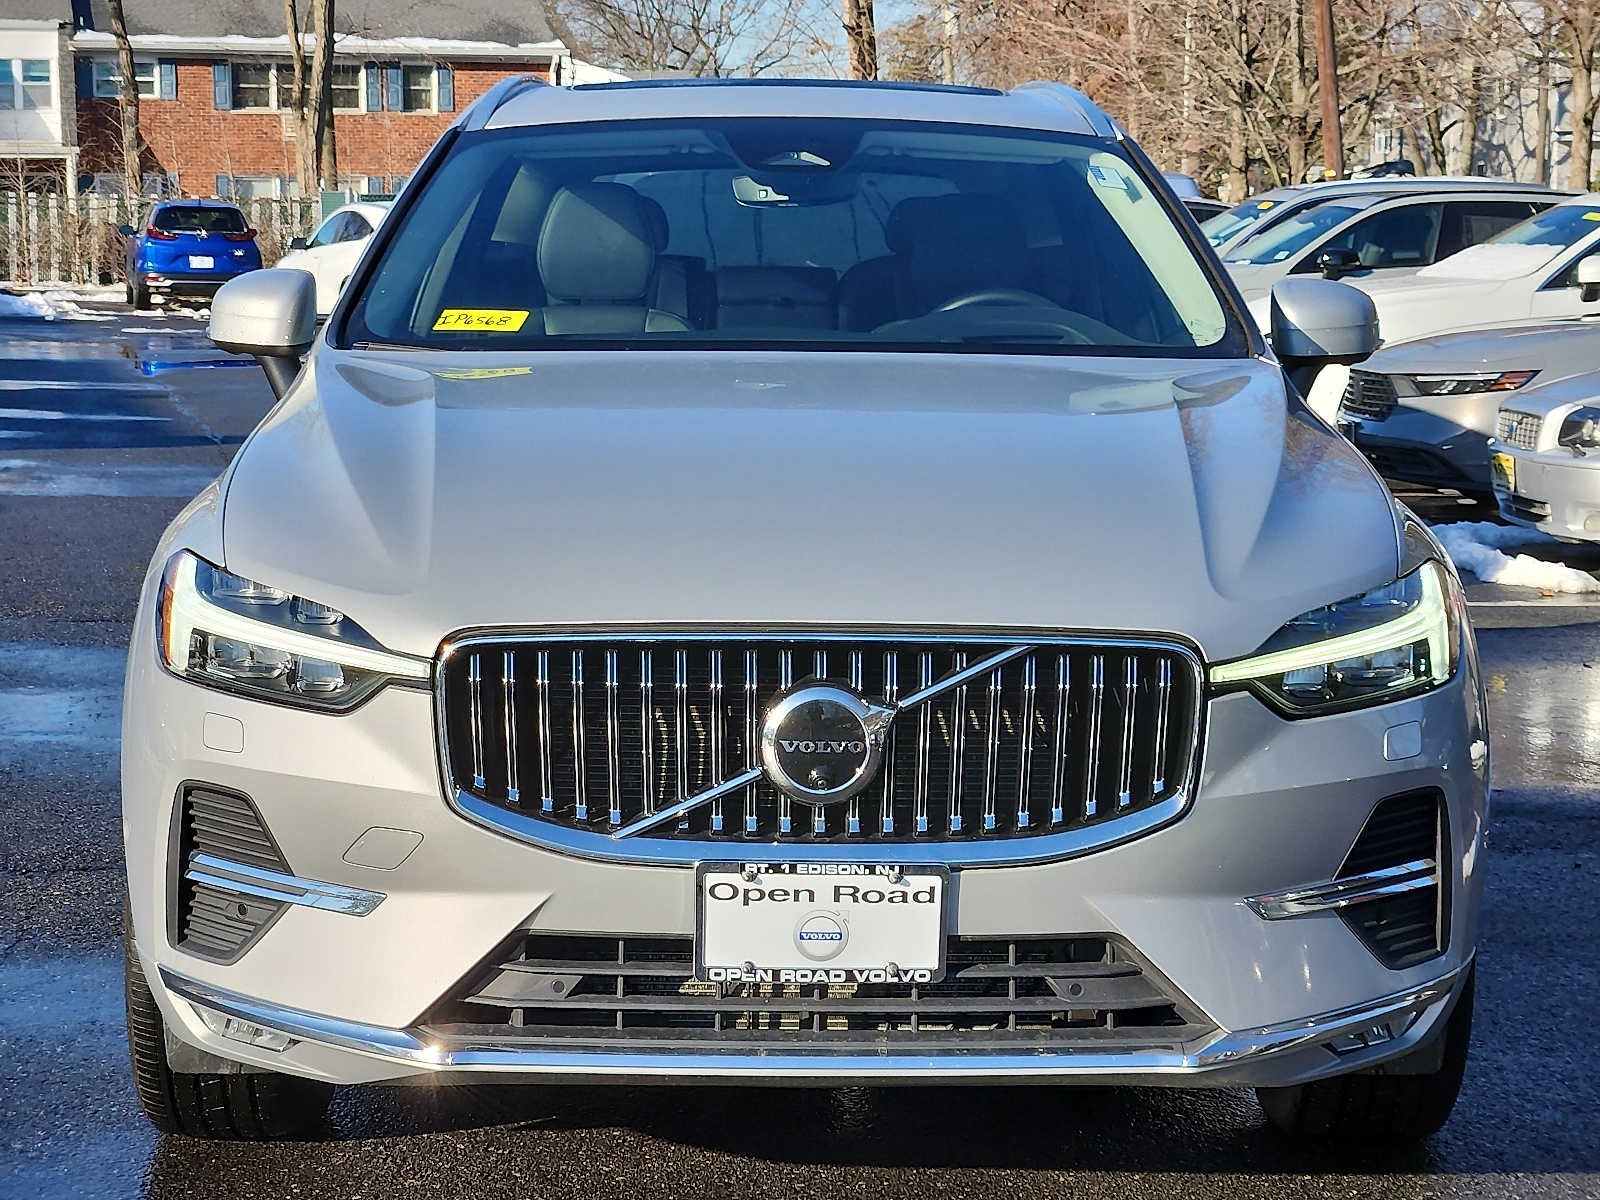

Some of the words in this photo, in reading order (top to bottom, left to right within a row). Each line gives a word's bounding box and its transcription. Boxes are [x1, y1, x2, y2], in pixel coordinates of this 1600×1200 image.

[779, 740, 865, 753] VOLVO
[744, 863, 774, 874] RT.
[781, 864, 790, 874] 1
[875, 865, 900, 875] NJ
[708, 882, 815, 906] Open
[833, 885, 935, 904] Road
[801, 932, 841, 940] VOLVO
[709, 968, 773, 982] OPEN
[780, 969, 846, 983] ROAD
[853, 969, 932, 983] VOLVO
